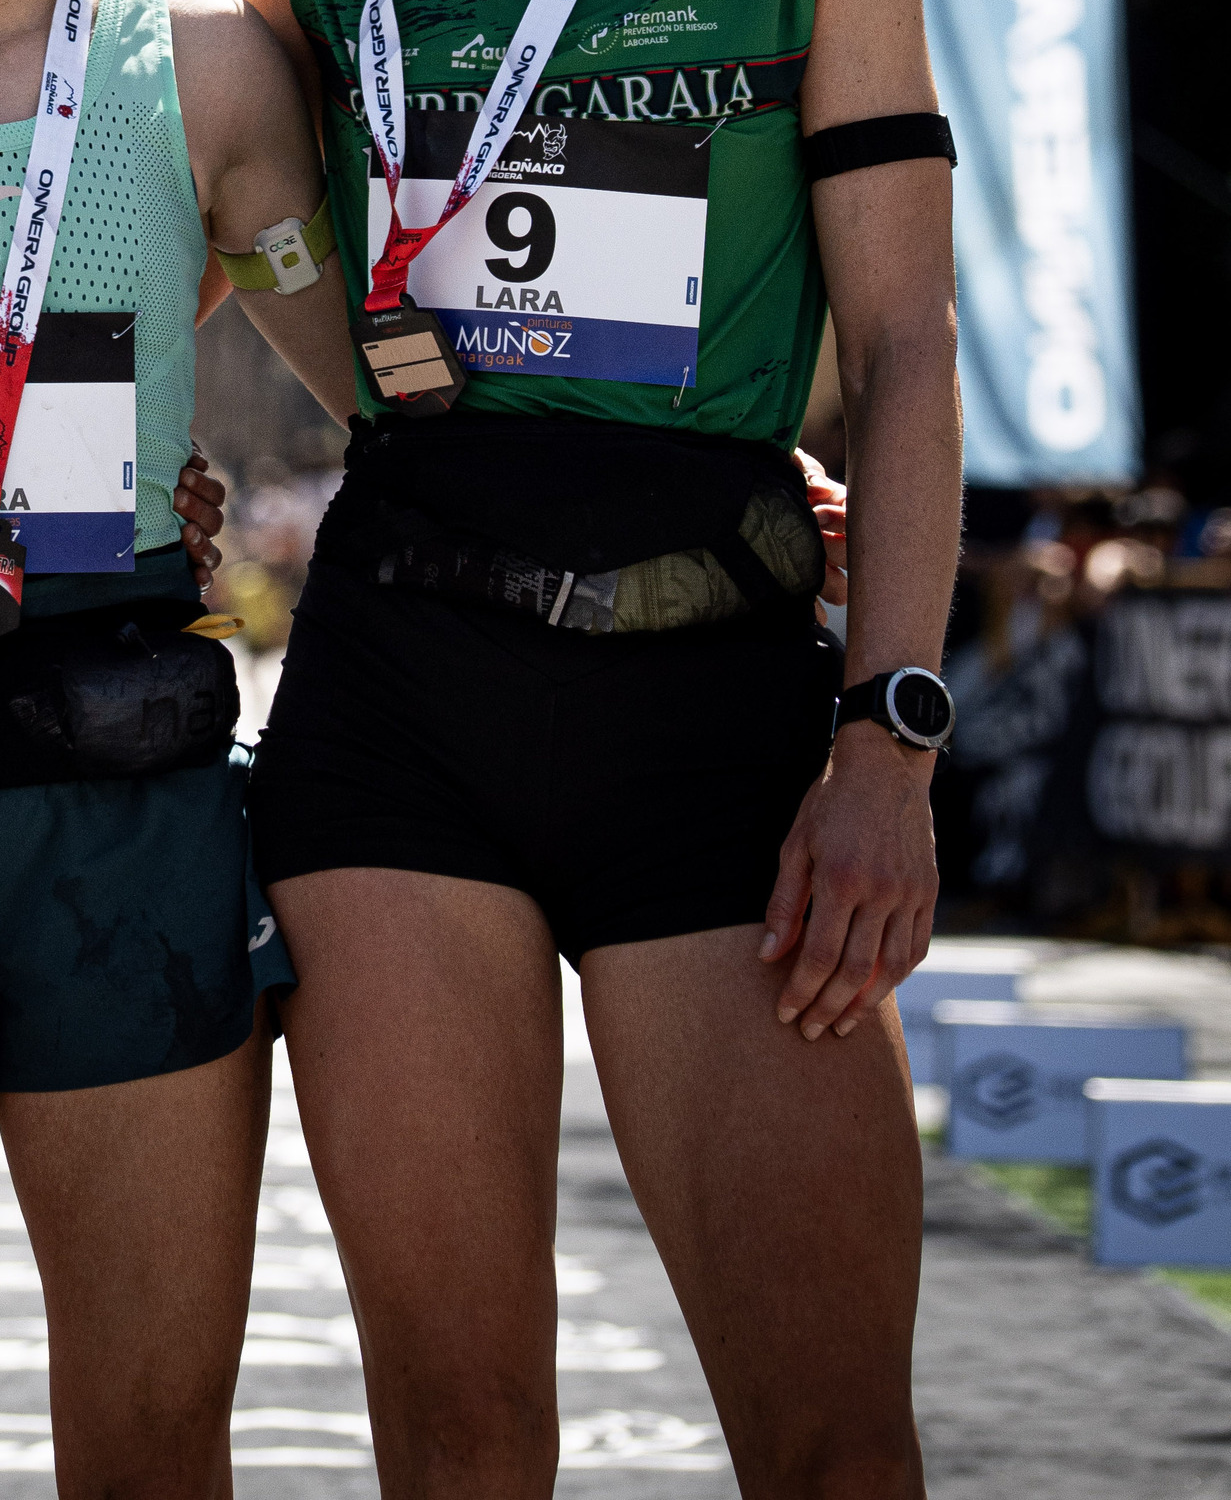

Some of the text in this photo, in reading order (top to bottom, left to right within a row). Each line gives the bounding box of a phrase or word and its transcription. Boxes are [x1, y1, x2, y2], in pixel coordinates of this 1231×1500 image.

[623, 5, 698, 26] Premank
[623, 21, 718, 36] PREVENCIÓN DE RIESGOS
[623, 35, 669, 47] LABORALES
[46, 71, 58, 115] ALOÑAKO
[374, 57, 398, 158] ONNERA
[484, 44, 537, 139] ONNERA
[491, 158, 566, 176] ALOÑAKO
[484, 191, 556, 283] 9
[5, 169, 54, 367] ONNERA GROUP
[476, 286, 564, 313] LARA
[456, 321, 572, 358] MUÑOZ
[526, 317, 573, 330] pinturas
